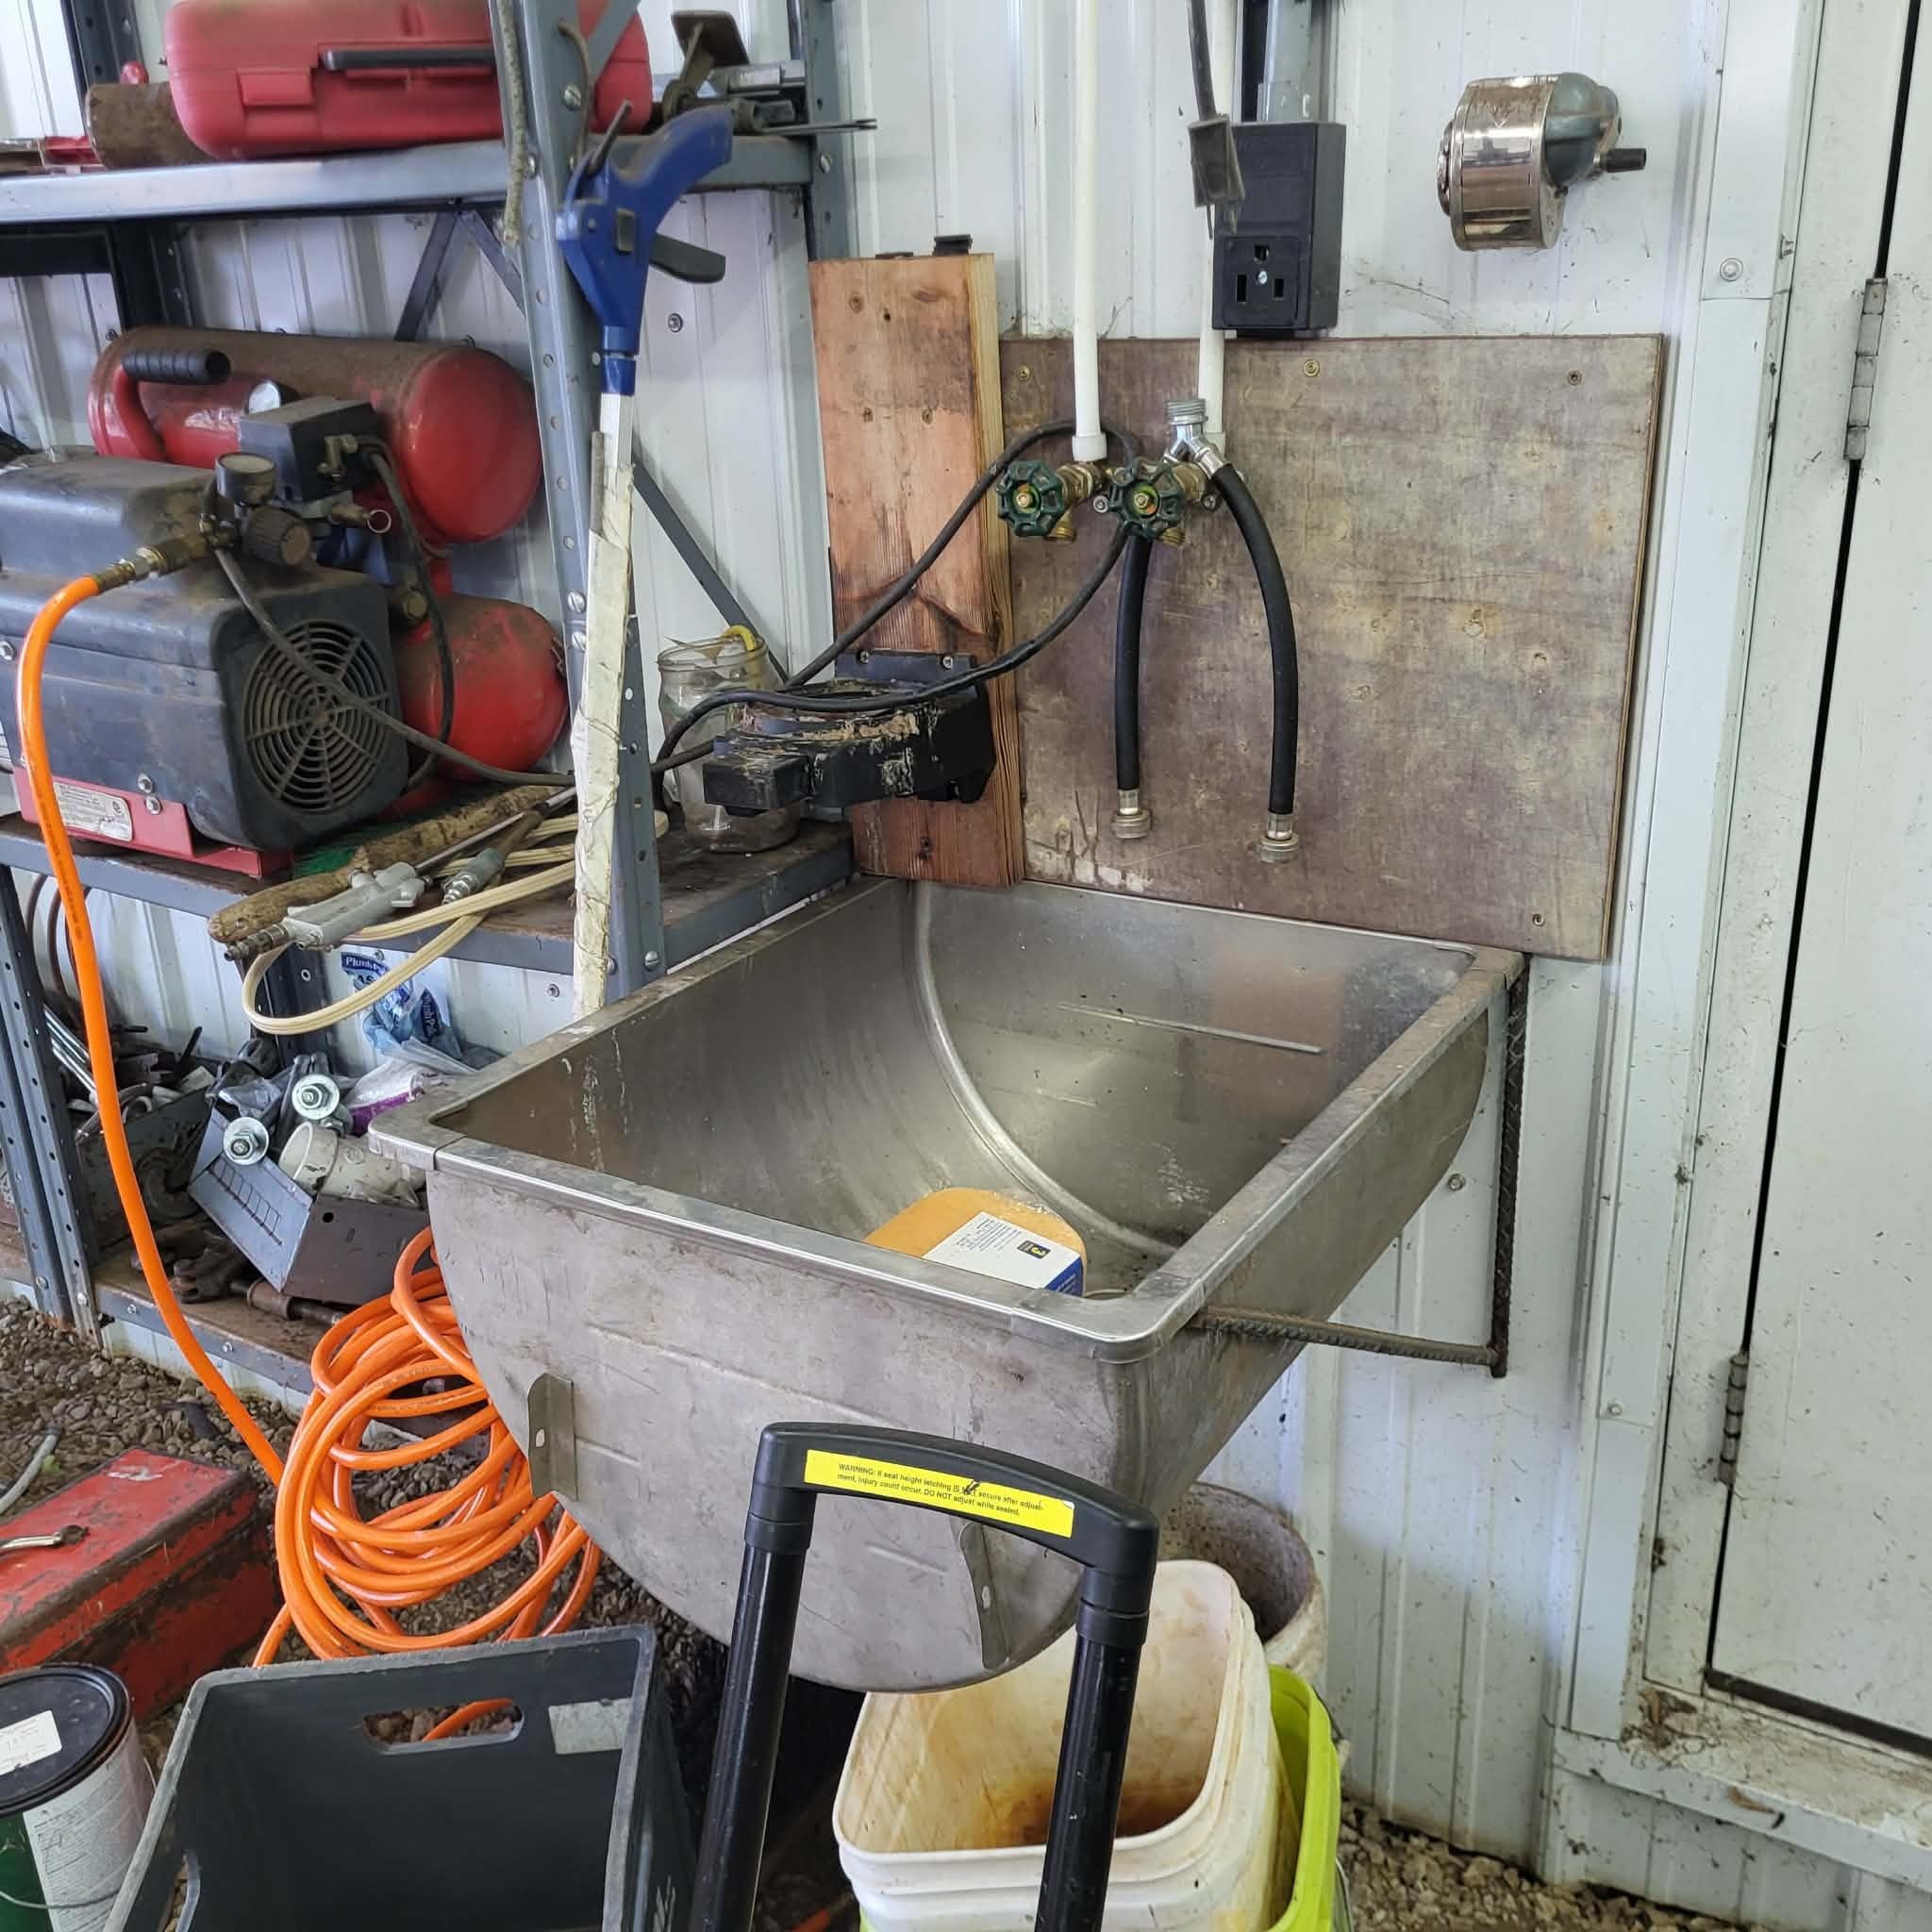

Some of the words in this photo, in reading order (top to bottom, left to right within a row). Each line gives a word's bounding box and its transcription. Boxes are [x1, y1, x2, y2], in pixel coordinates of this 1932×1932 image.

[838, 1463, 875, 1476] WARNING:
[877, 1469, 883, 1477] If
[884, 1471, 899, 1481] seat
[900, 1474, 923, 1485] height
[924, 1478, 951, 1491] latching
[961, 1486, 977, 1495] NT
[978, 1491, 1002, 1502] secure
[1003, 1495, 1020, 1506] after
[858, 1477, 878, 1488] injury
[879, 1480, 900, 1491] could
[924, 1489, 935, 1497] DO
[936, 1491, 952, 1502] NOT
[953, 1495, 975, 1507] adjust
[976, 1500, 995, 1510] while
